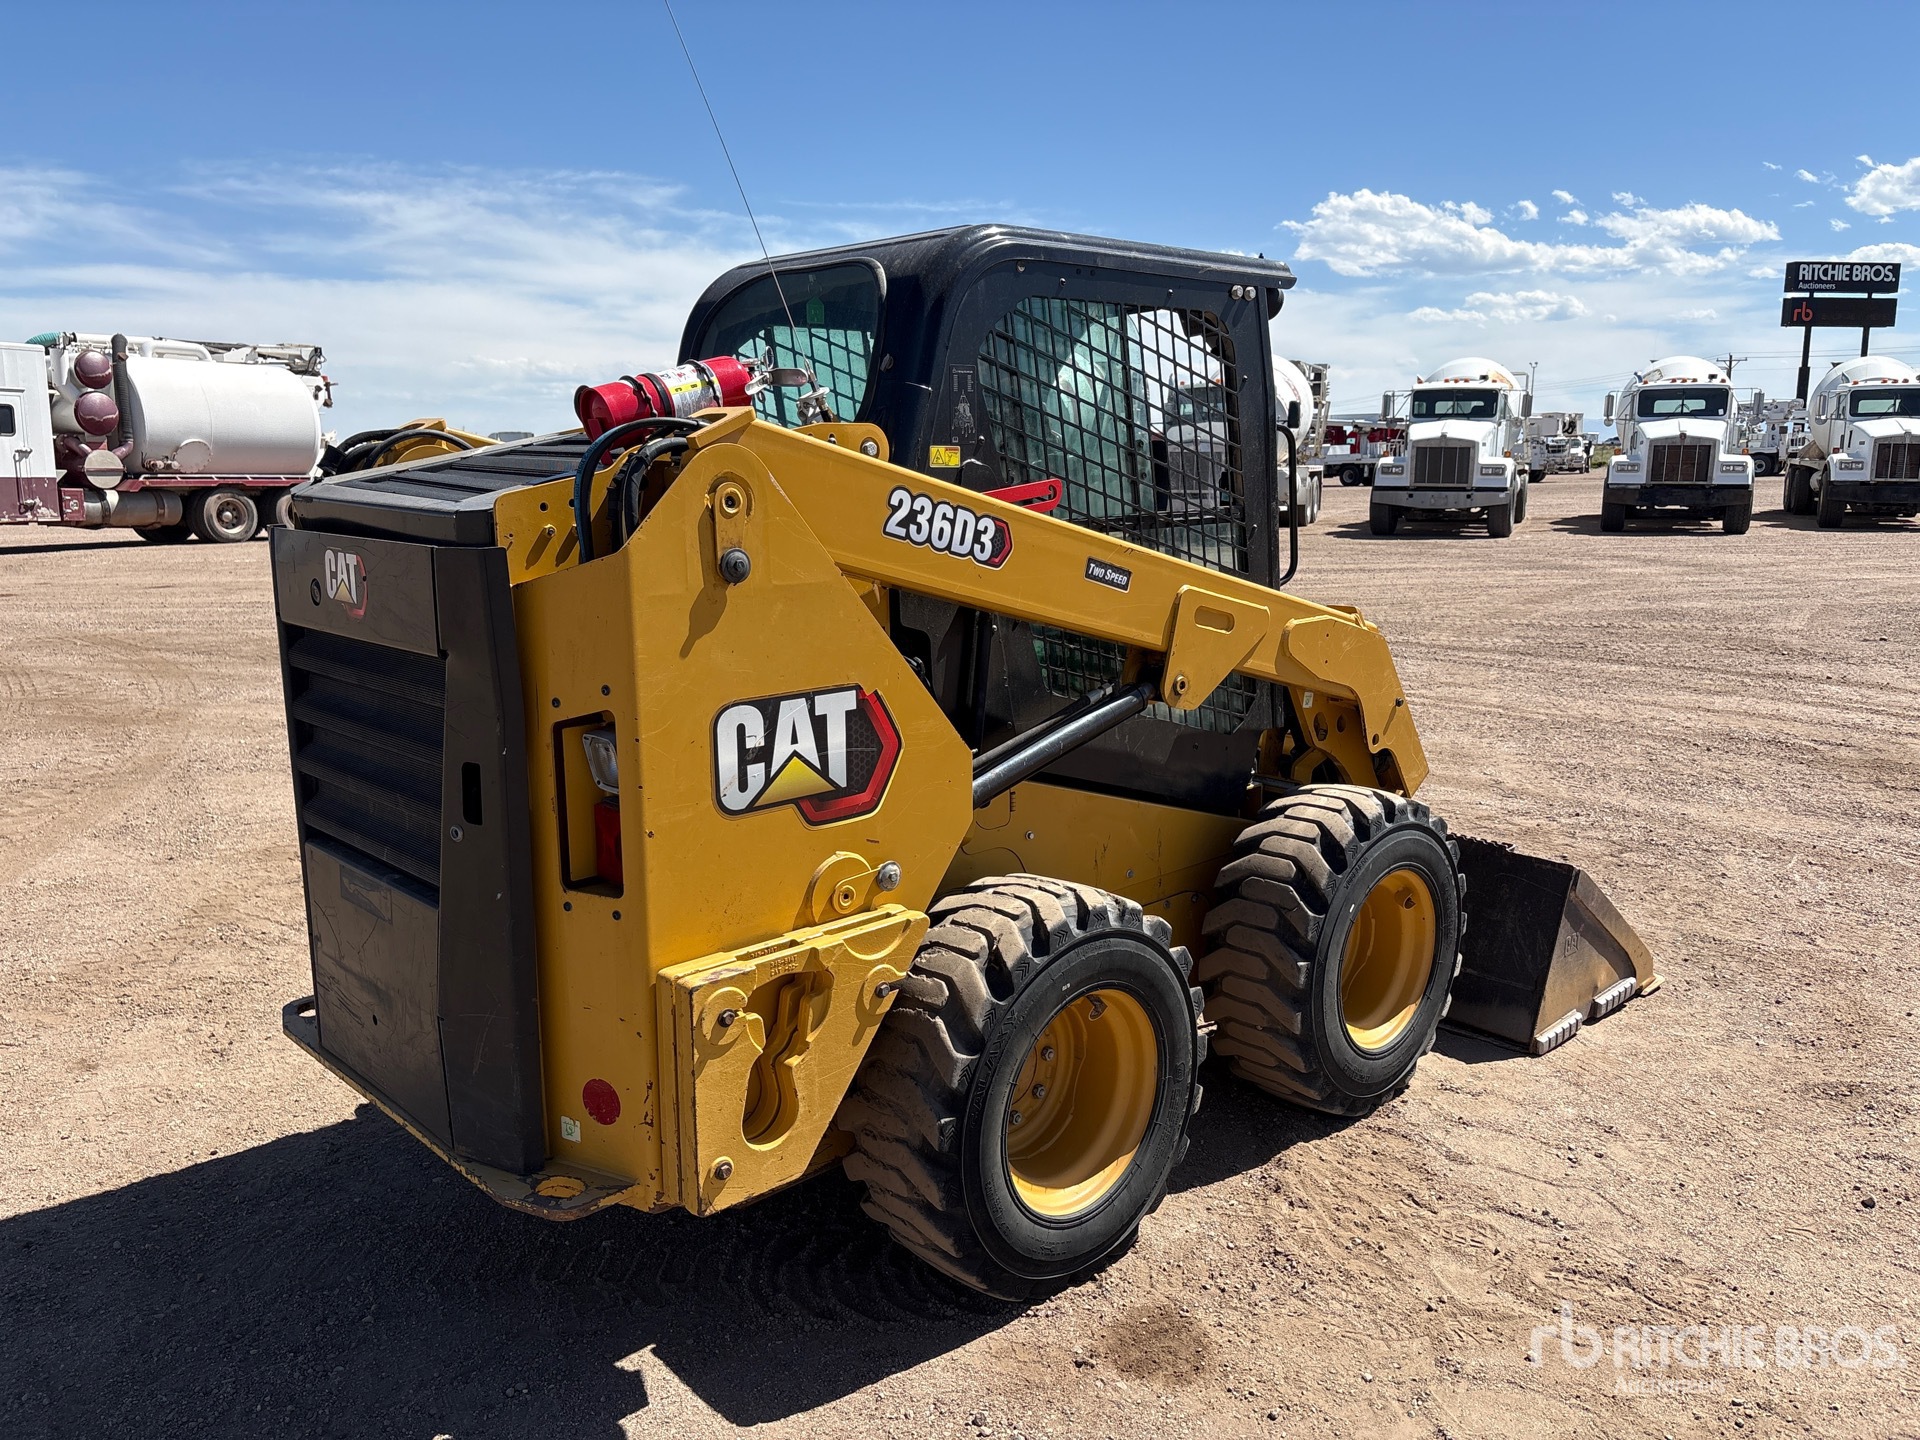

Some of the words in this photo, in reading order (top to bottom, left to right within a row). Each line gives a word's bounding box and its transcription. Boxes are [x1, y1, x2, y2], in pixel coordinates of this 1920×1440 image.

[1798, 264, 1850, 281] RITCHIE
[1852, 265, 1896, 282] BROS.
[1798, 282, 1836, 290] Auctioneers
[886, 487, 997, 563] 236D3
[324, 549, 358, 604] CAT
[716, 689, 857, 811] CAT
